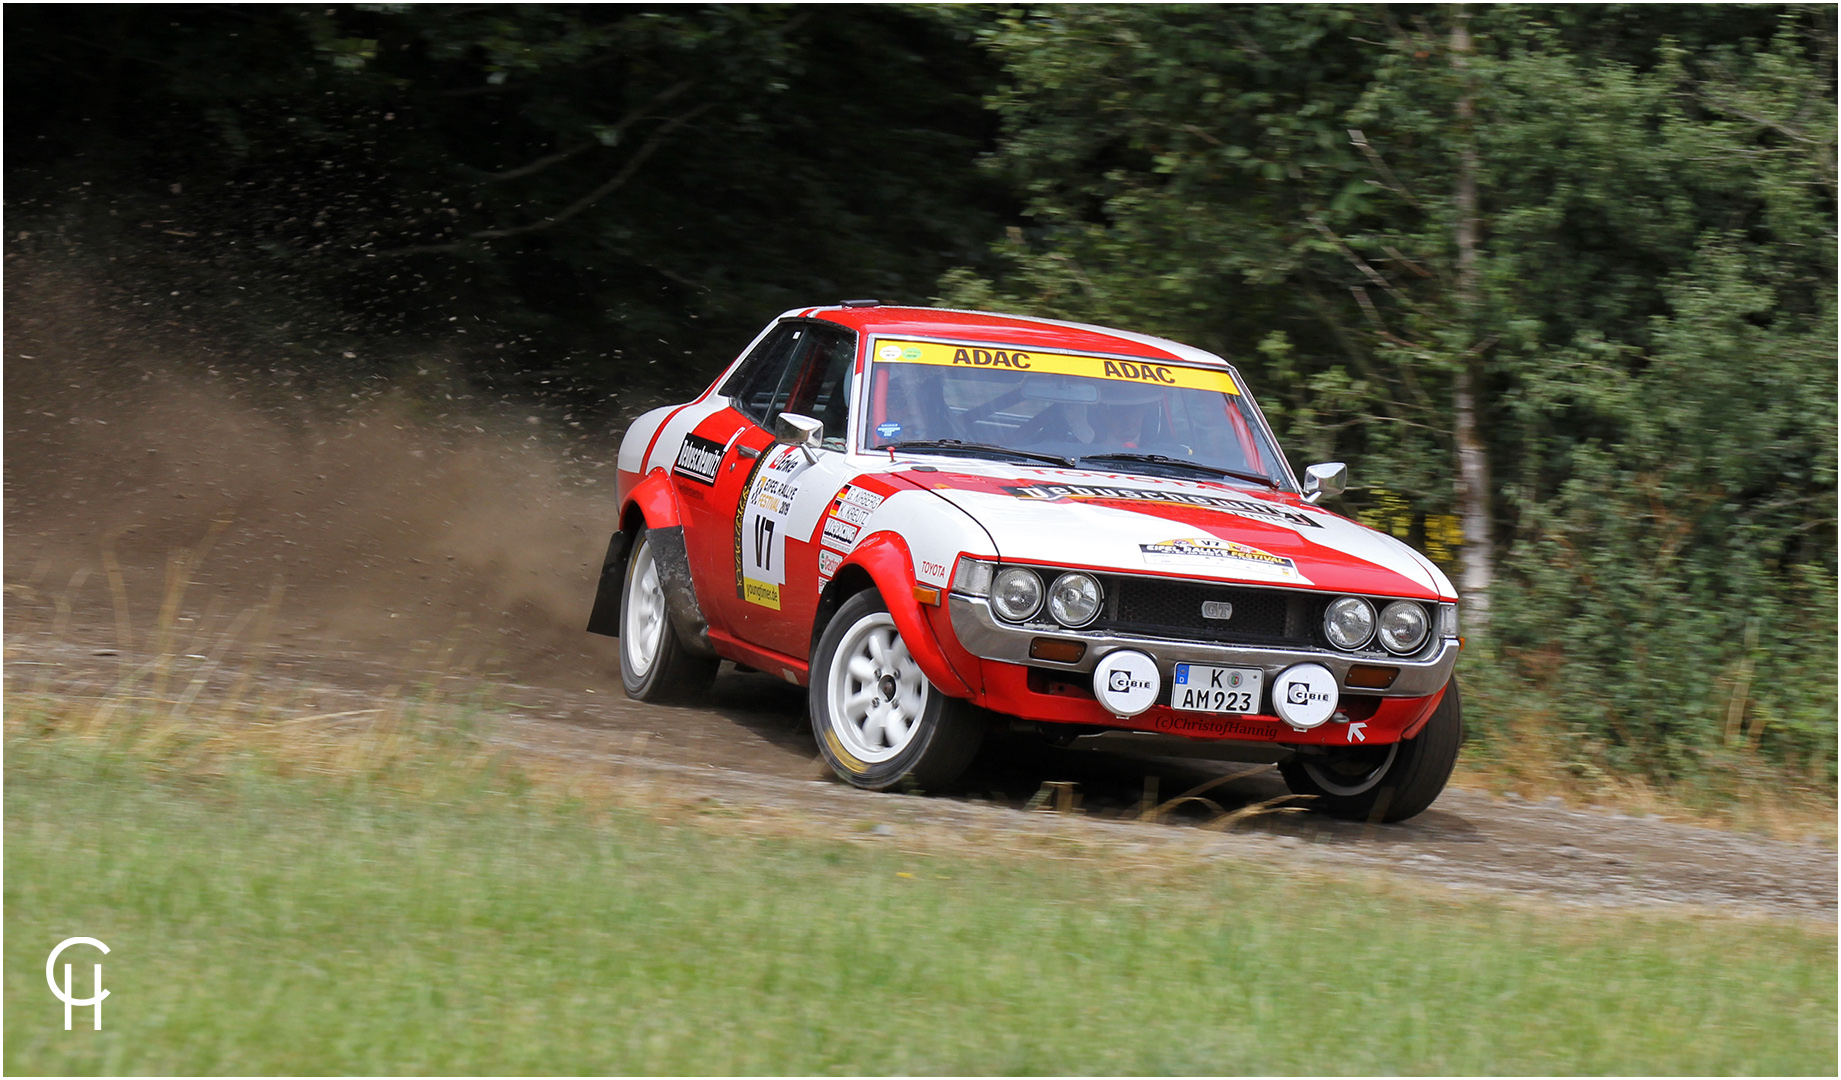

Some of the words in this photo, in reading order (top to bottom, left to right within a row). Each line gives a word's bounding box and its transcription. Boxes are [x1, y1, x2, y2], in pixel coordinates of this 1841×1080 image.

[952, 348, 1031, 369] ADAC
[1103, 360, 1176, 384] ADAC
[764, 478, 779, 494] EIFEL
[778, 483, 798, 501] RALLYE
[1020, 468, 1232, 493] TOYOTA
[757, 493, 780, 512] FESTIVAL
[755, 514, 775, 571] V7
[1183, 546, 1228, 556] RALLYE
[1231, 551, 1286, 564] FESTIVAL
[921, 561, 946, 578] TOYOTA
[1204, 602, 1230, 618] GT
[1210, 669, 1224, 688] K
[1182, 689, 1210, 709] AM
[1213, 691, 1252, 712] 923
